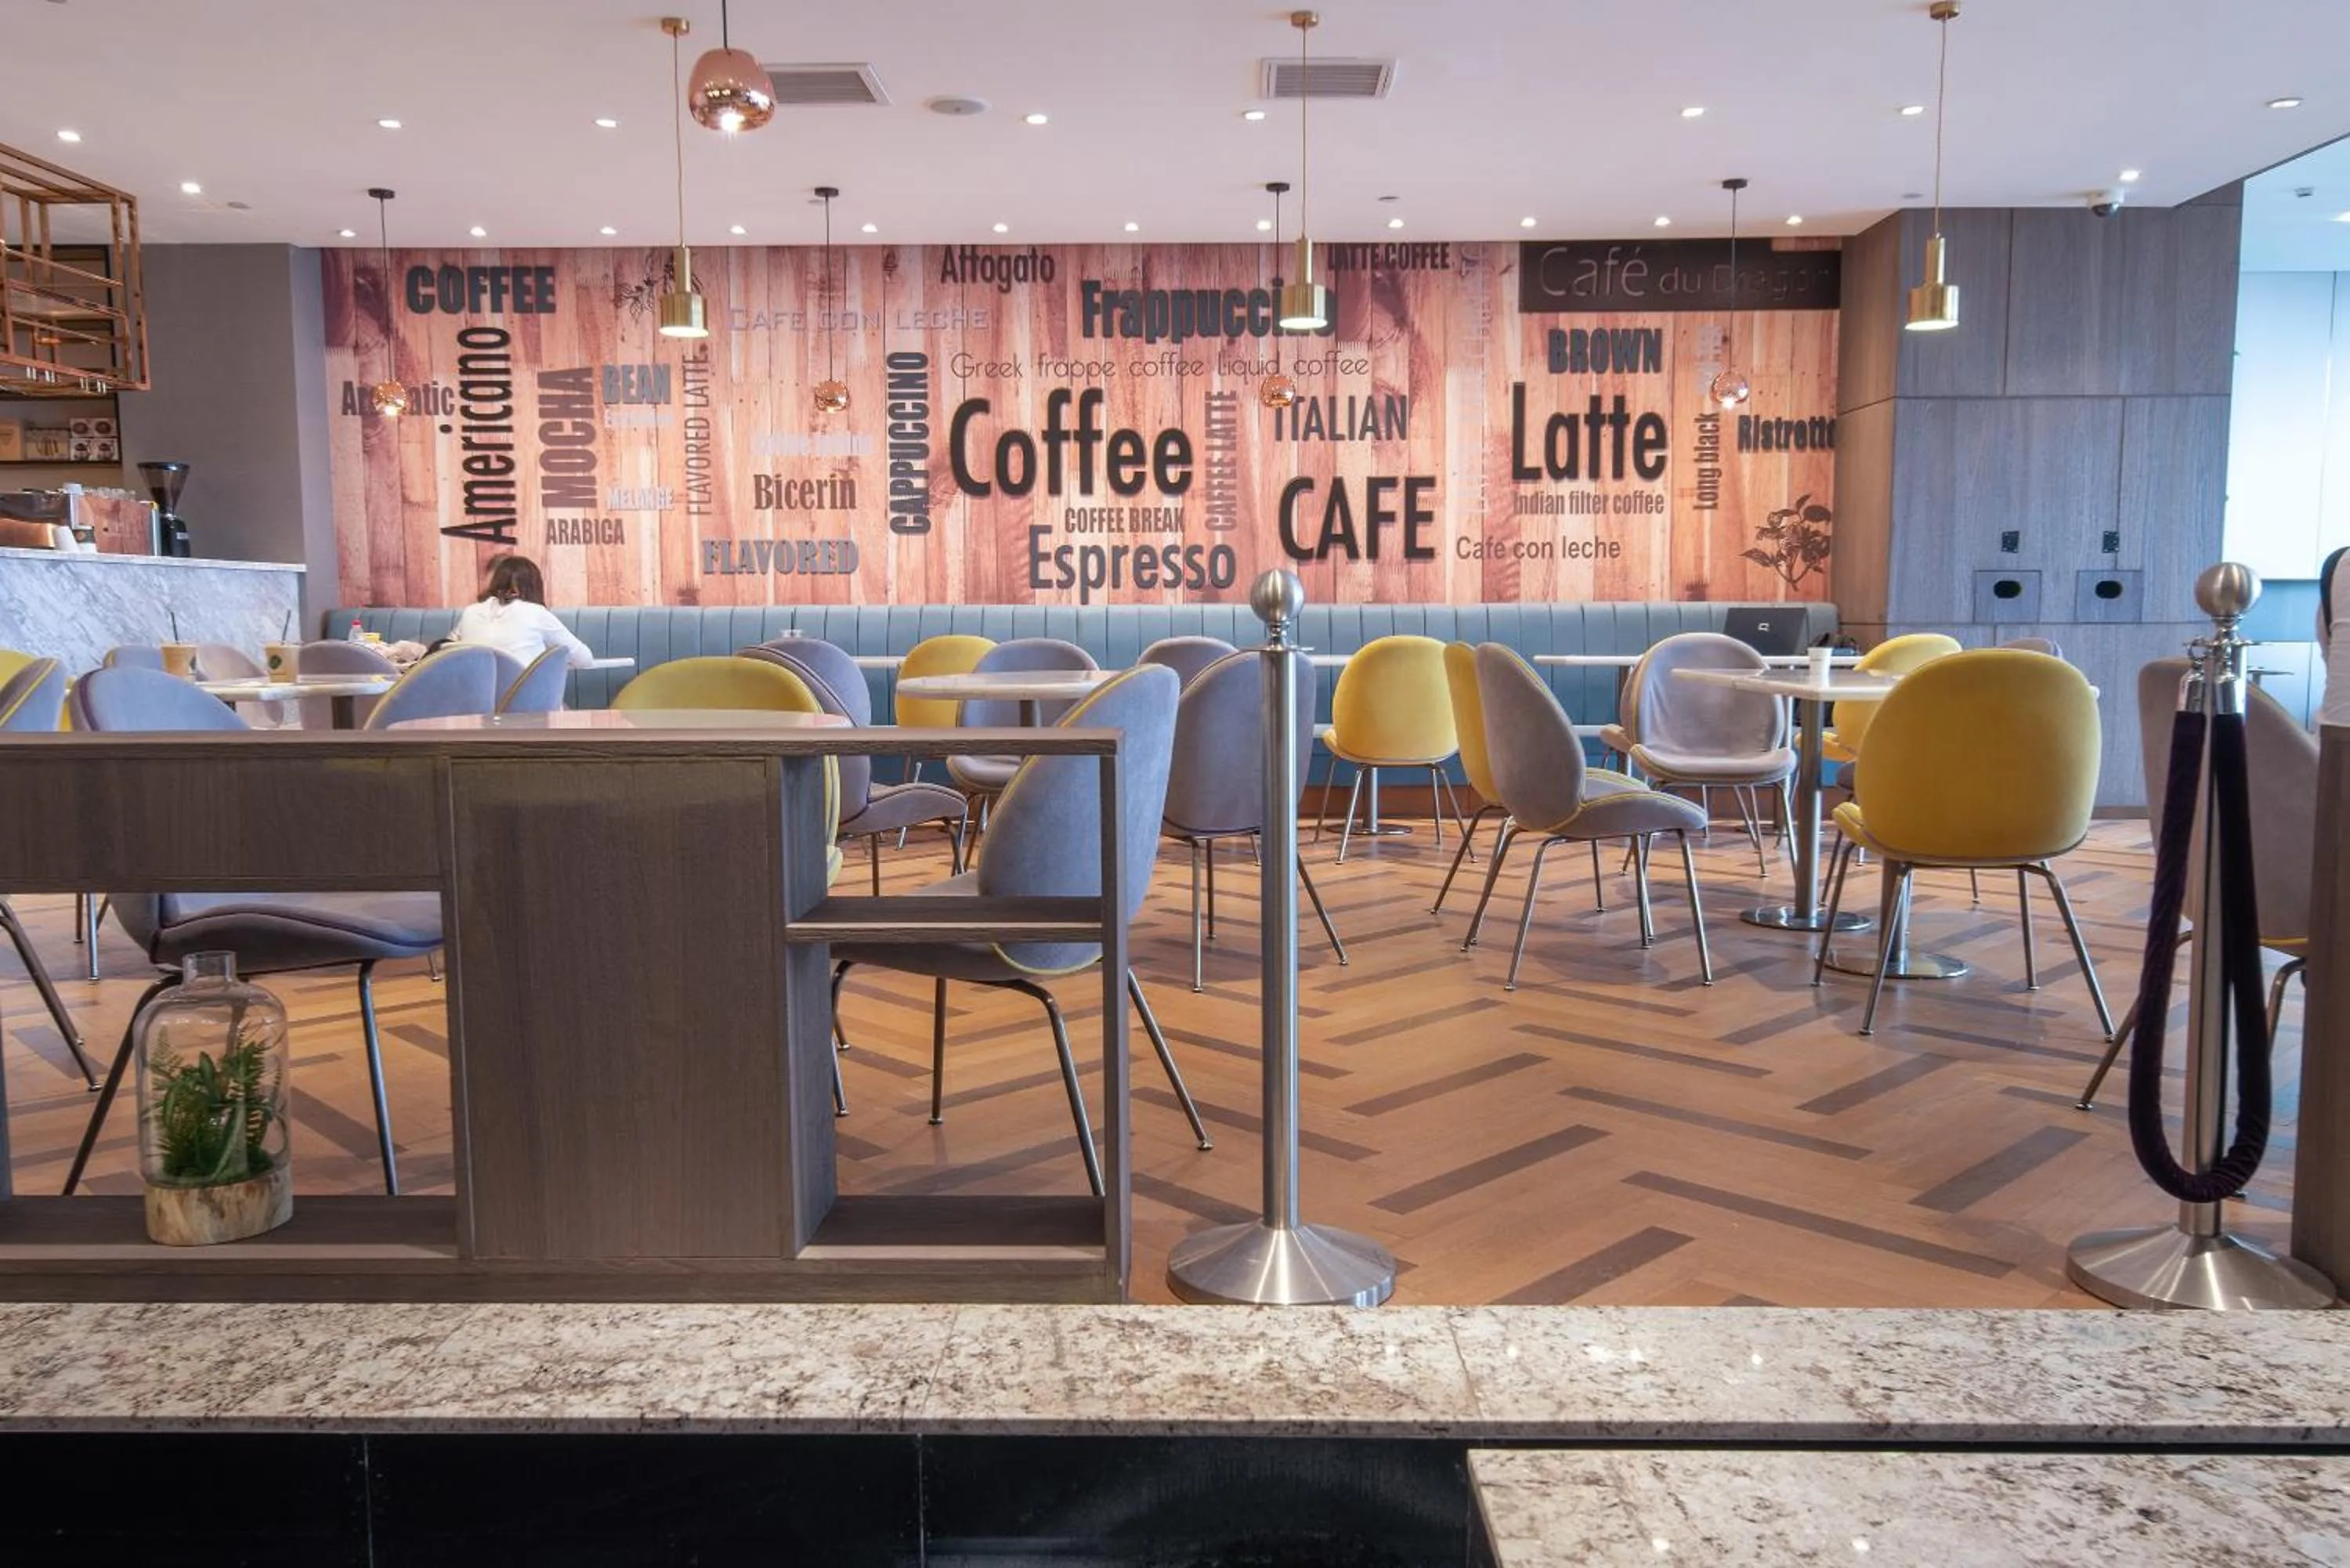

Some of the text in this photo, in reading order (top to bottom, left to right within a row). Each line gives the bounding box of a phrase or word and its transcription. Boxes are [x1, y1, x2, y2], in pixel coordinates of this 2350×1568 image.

[1328, 243, 1451, 269] LATTE COFFEE
[1539, 245, 1648, 297] Café
[1658, 266, 1702, 294] du
[405, 265, 557, 314] COFFEE
[1081, 278, 1338, 345] Frappuccio
[950, 352, 1024, 378] Greek
[1038, 352, 1116, 386] frappe
[1128, 352, 1204, 378] coffee
[1293, 350, 1369, 377] coffee
[1548, 327, 1663, 374] BROWN
[342, 380, 456, 417] Aratic
[602, 363, 672, 405] BEAN
[439, 326, 518, 545] Americano
[537, 366, 598, 509] MOCHA
[949, 387, 1194, 498] Coffee
[1275, 396, 1408, 442] ITALIAN
[1512, 381, 1668, 482] Latte
[1693, 412, 1720, 463] black
[684, 417, 712, 515] FLAVORED
[887, 352, 931, 536] CAPPUCCINO
[1204, 390, 1238, 532] CAFFEE LATTE
[753, 473, 858, 511] Bicerin
[1513, 490, 1665, 515] Indian filter coffee
[1693, 468, 1723, 511] Long
[546, 517, 626, 546] ARABICA
[1065, 507, 1185, 533] COFFEE BREAK
[1278, 475, 1437, 562] CAFE
[702, 540, 859, 576] FLAVORED
[1028, 524, 1237, 605] Espresso
[1455, 535, 1622, 560] Cafe con leche
